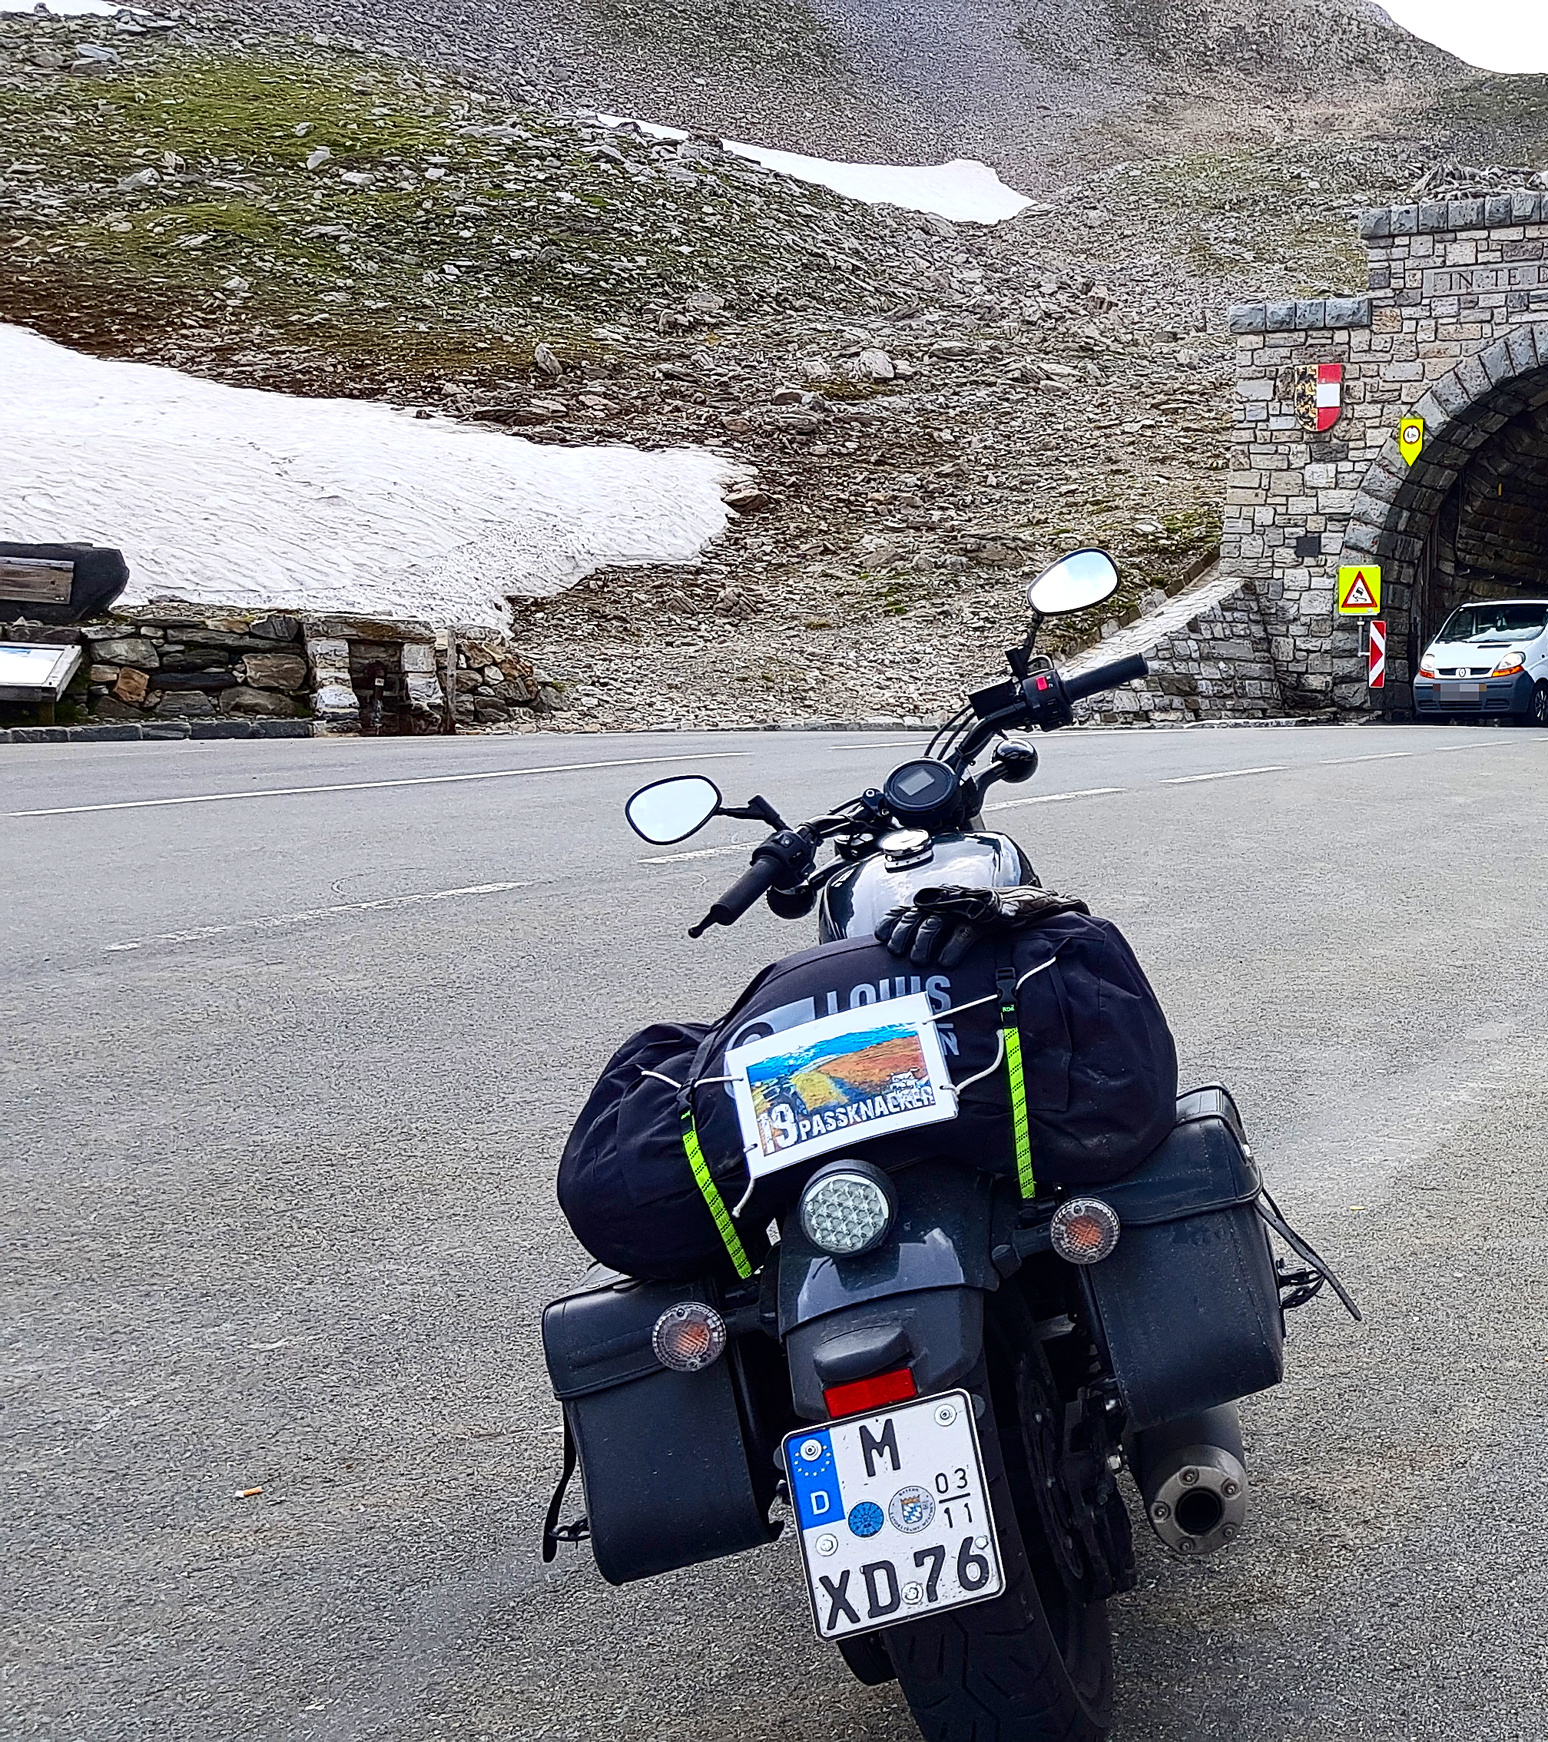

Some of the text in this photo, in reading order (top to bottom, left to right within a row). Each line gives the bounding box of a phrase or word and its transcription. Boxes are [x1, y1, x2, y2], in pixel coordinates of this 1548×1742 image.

[1450, 271, 1475, 291] IN
[1490, 267, 1521, 287] TE
[800, 1086, 935, 1141] PASSKNACKER
[859, 1419, 901, 1477] M
[935, 1468, 968, 1494] 03
[810, 1490, 830, 1515] D
[944, 1503, 973, 1528] 11
[819, 1537, 990, 1631] XD 76
